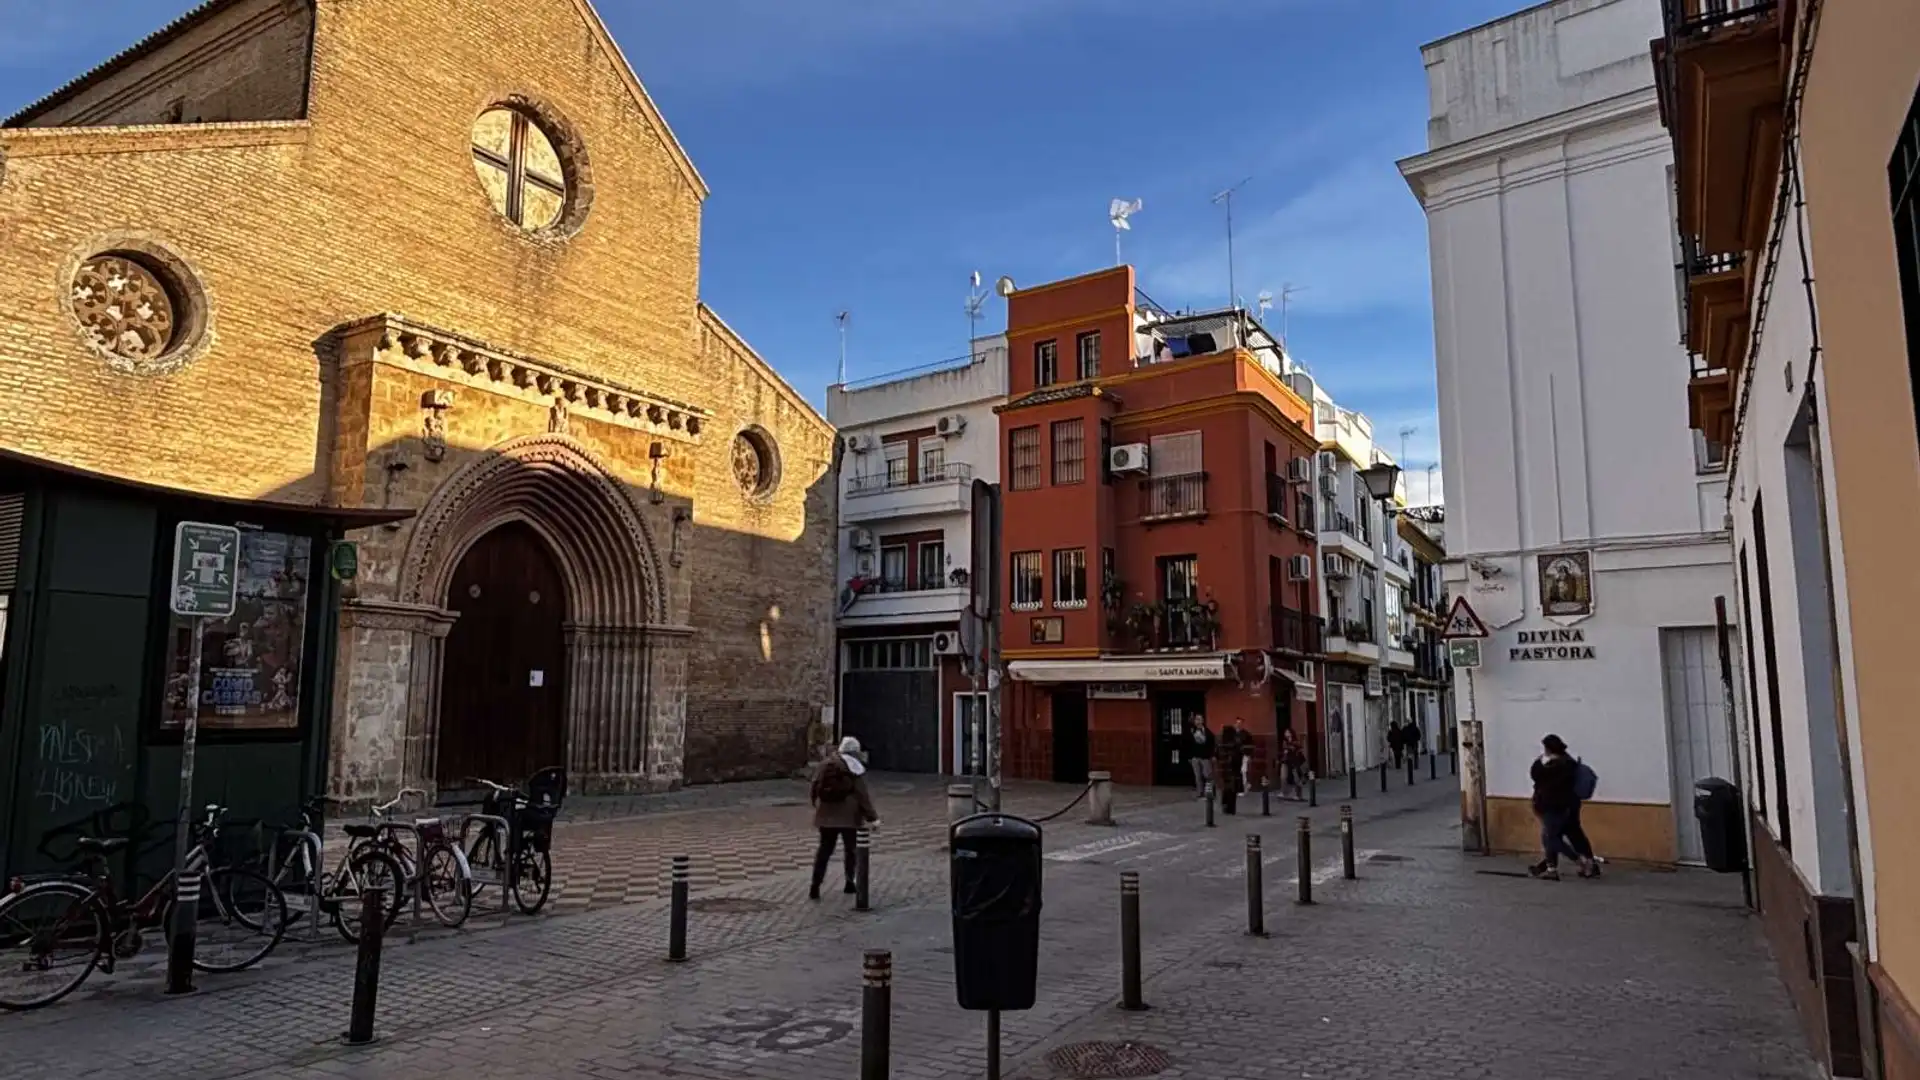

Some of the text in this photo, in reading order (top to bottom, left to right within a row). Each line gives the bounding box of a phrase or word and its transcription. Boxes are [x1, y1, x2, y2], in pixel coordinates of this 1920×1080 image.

[1518, 630, 1584, 644] DIVINA
[1510, 646, 1595, 660] PASTORA
[1158, 668, 1184, 676] SANTA
[1186, 667, 1219, 676] MARINA
